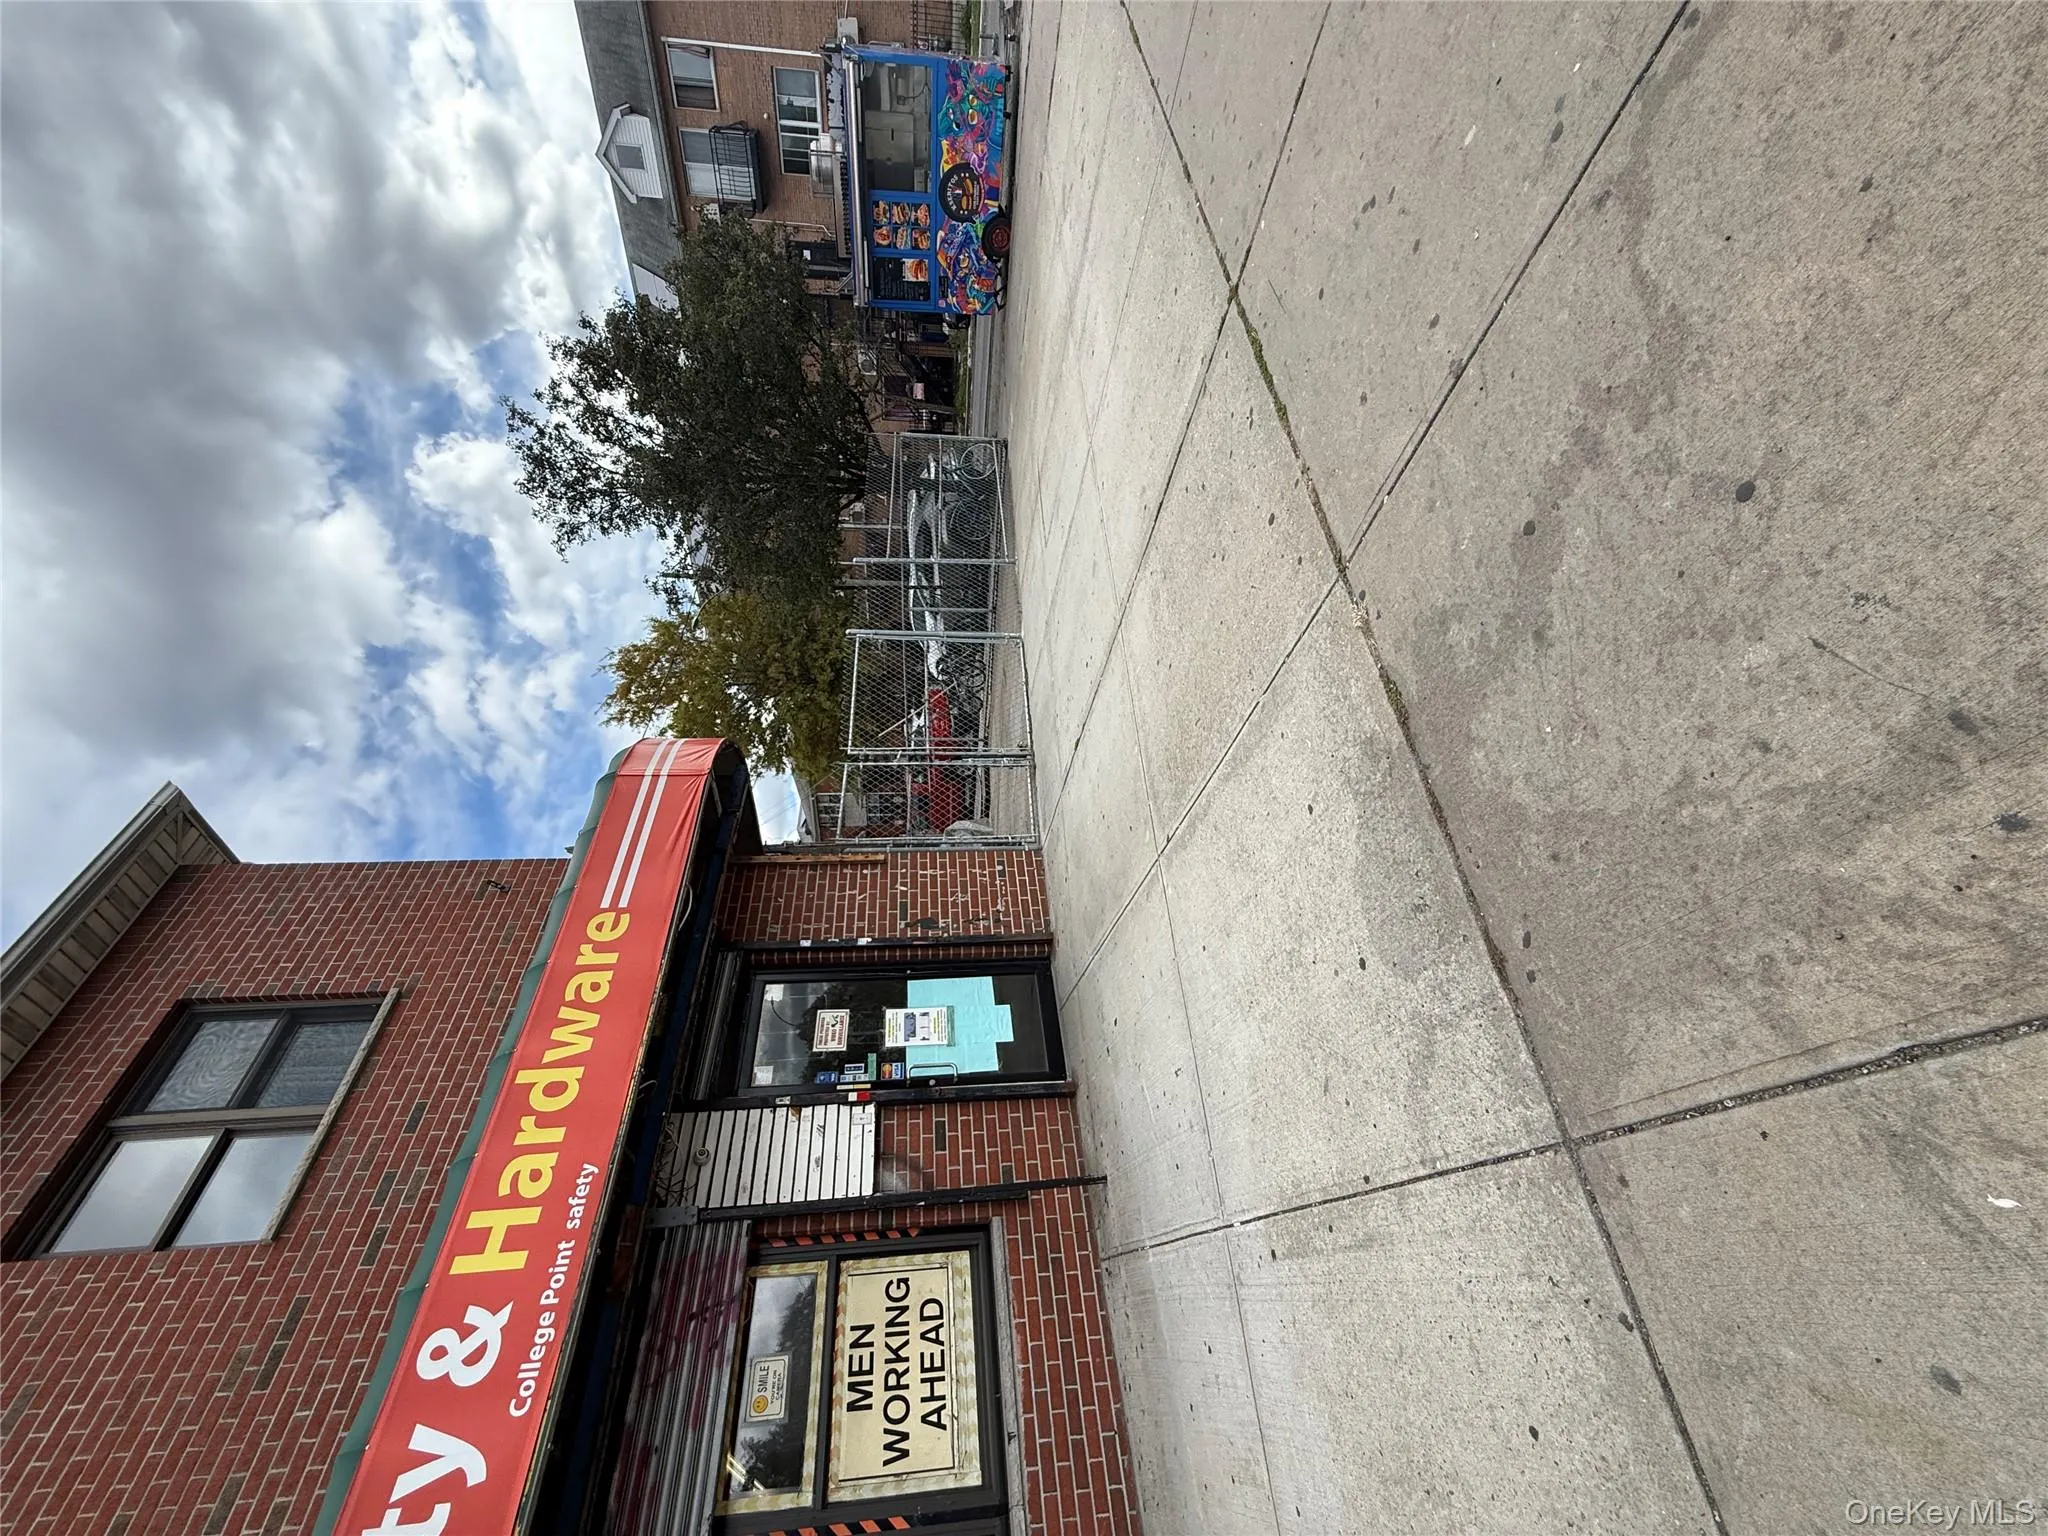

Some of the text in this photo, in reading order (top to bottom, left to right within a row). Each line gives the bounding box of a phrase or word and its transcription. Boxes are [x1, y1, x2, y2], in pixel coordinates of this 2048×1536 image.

[450, 911, 630, 1275] Hardware
[416, 1301, 513, 1388] &
[508, 1162, 600, 1418] College Point safety
[757, 1365, 769, 1393] SMILE
[772, 1369, 777, 1379] ON
[846, 1323, 876, 1411] MEN
[882, 1277, 911, 1467] WORKING
[919, 1297, 948, 1431] AHEAD
